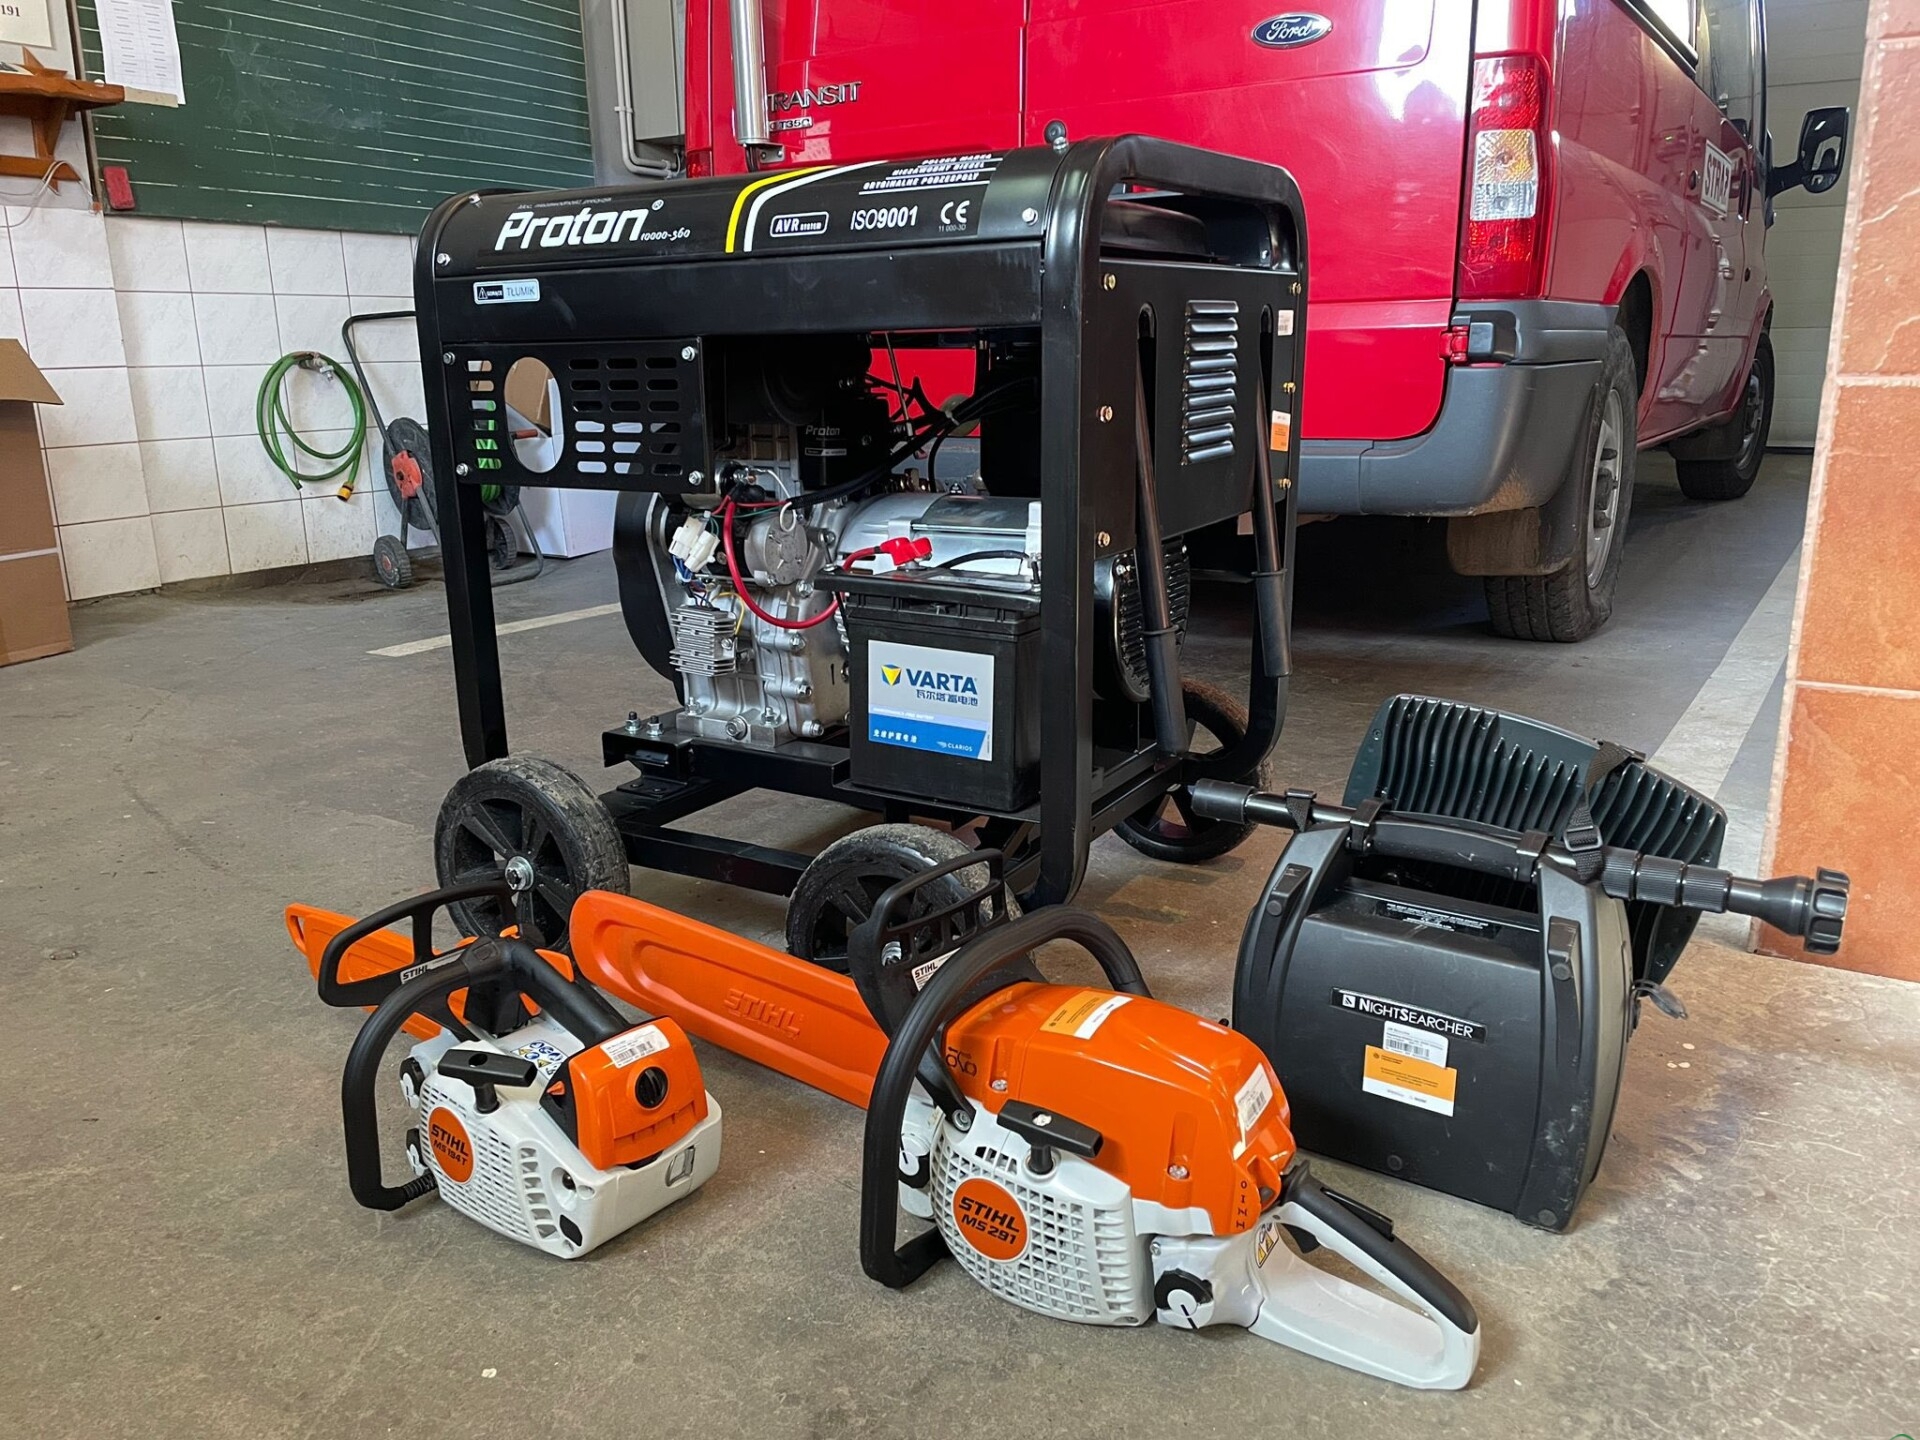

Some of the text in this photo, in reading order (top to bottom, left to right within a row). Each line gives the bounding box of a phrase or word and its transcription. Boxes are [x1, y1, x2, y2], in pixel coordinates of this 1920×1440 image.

[1266, 18, 1313, 40] Ford
[767, 81, 861, 112] TRANSIT
[494, 207, 649, 251] Proton
[775, 218, 800, 233] AVR
[850, 205, 918, 231] ISO9001
[805, 424, 841, 436] Proton
[906, 668, 978, 695] VARTA
[947, 742, 973, 753] CLARIOS
[402, 964, 428, 981] STIHL
[913, 961, 938, 979] STIHL
[723, 987, 801, 1037] STIHL
[430, 1123, 469, 1158] STIHL
[958, 1195, 1020, 1234] STIHL
[961, 1213, 1017, 1245] MS 291
